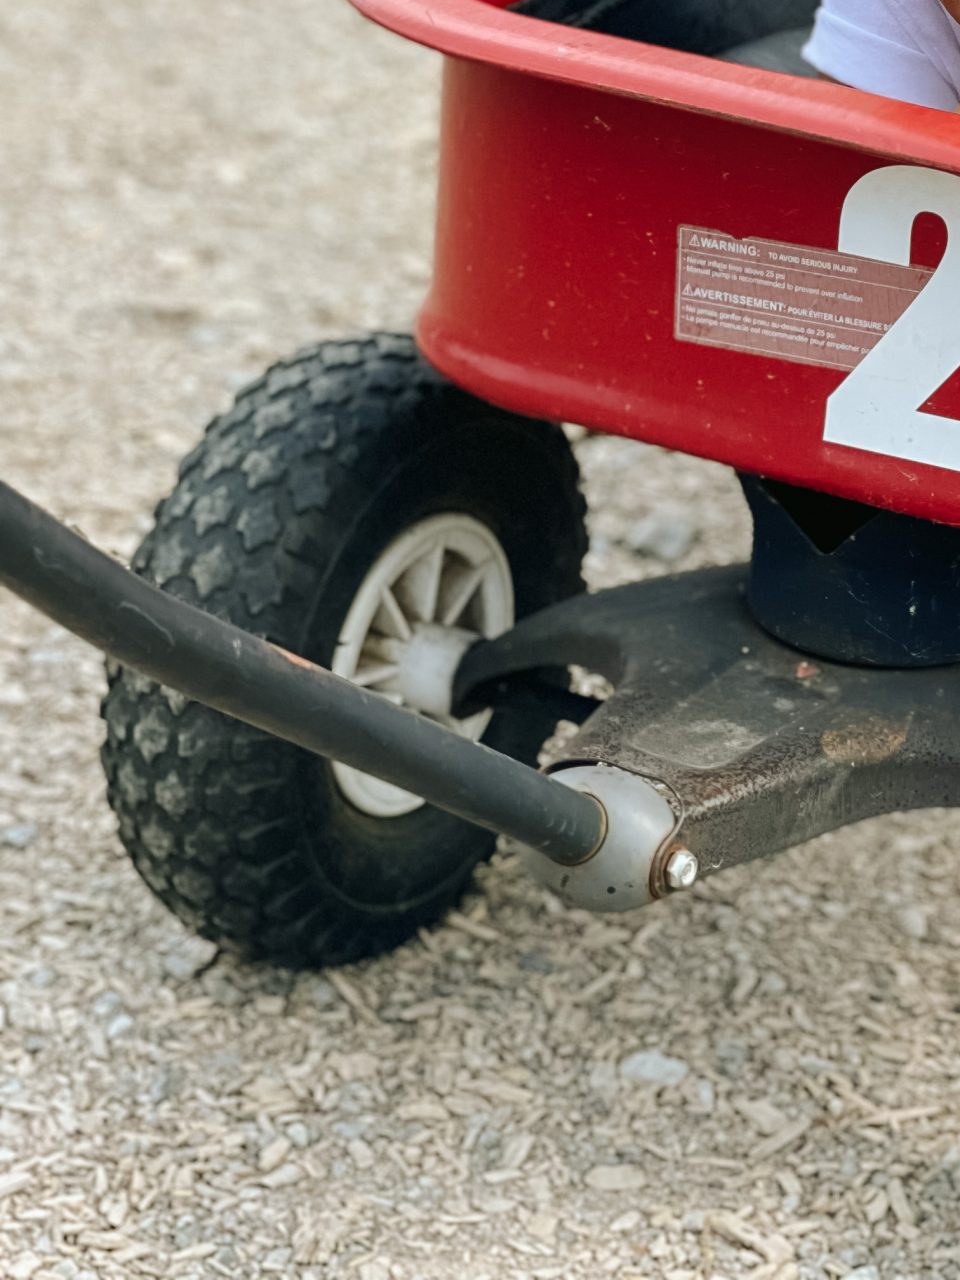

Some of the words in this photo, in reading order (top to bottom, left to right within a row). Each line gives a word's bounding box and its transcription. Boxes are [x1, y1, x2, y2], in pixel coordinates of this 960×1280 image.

[700, 237, 761, 257] WARNING:
[768, 252, 778, 260] TO
[779, 254, 800, 264] AVOID
[801, 258, 832, 270] SERIOUS
[833, 264, 858, 274] INJURY
[765, 270, 775, 278] 25
[775, 272, 785, 281] psi
[786, 282, 794, 291] to
[794, 285, 820, 296] prevent
[821, 290, 836, 298] over
[693, 287, 787, 312] AVERTISSEMENT:
[787, 307, 808, 317] POUR
[834, 315, 844, 323] LA
[844, 316, 883, 330] BLESSURE
[816, 328, 825, 337] 25
